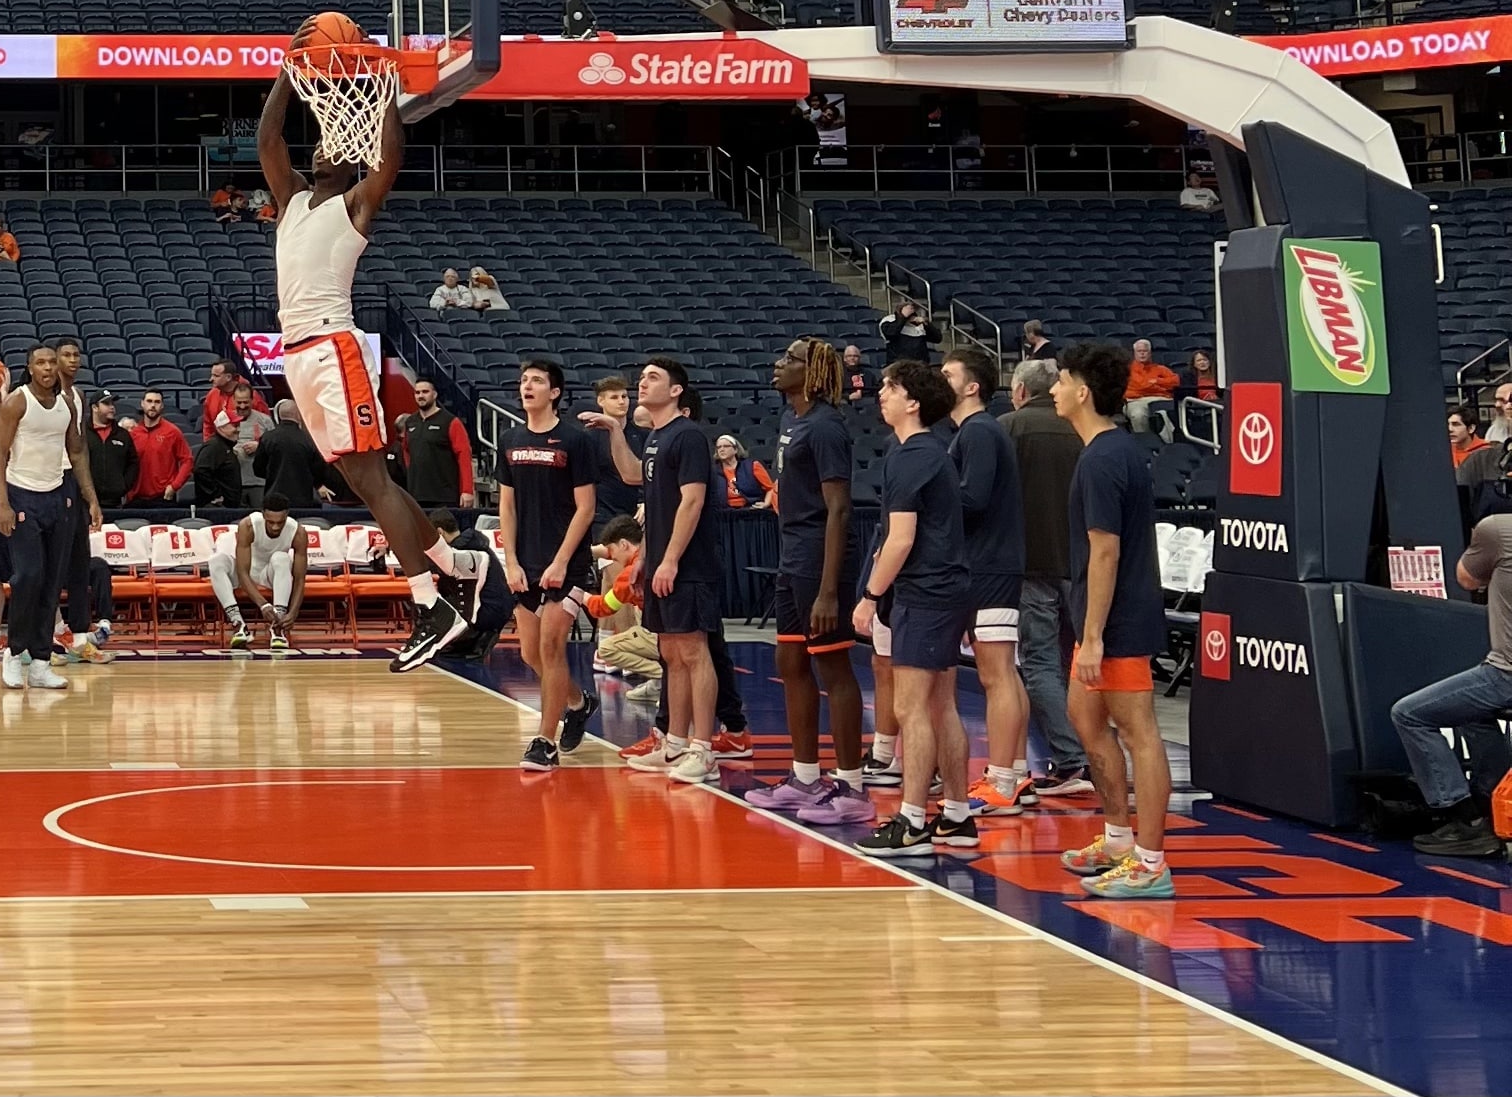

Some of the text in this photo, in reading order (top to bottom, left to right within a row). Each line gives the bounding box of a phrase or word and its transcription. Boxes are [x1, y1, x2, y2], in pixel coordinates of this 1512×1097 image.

[896, 19, 974, 28] CHEVROLET
[1004, 8, 1120, 25] Chevy Dealers
[98, 46, 286, 66] DOWNLOAD TOD
[1284, 29, 1491, 64] OWNLOAD TODAY
[1294, 246, 1368, 376] LIBMAN
[357, 404, 372, 425] S
[512, 450, 555, 462] SYRACUSE
[1220, 518, 1289, 552] TOYOTA
[1236, 636, 1309, 675] TOYOTA
